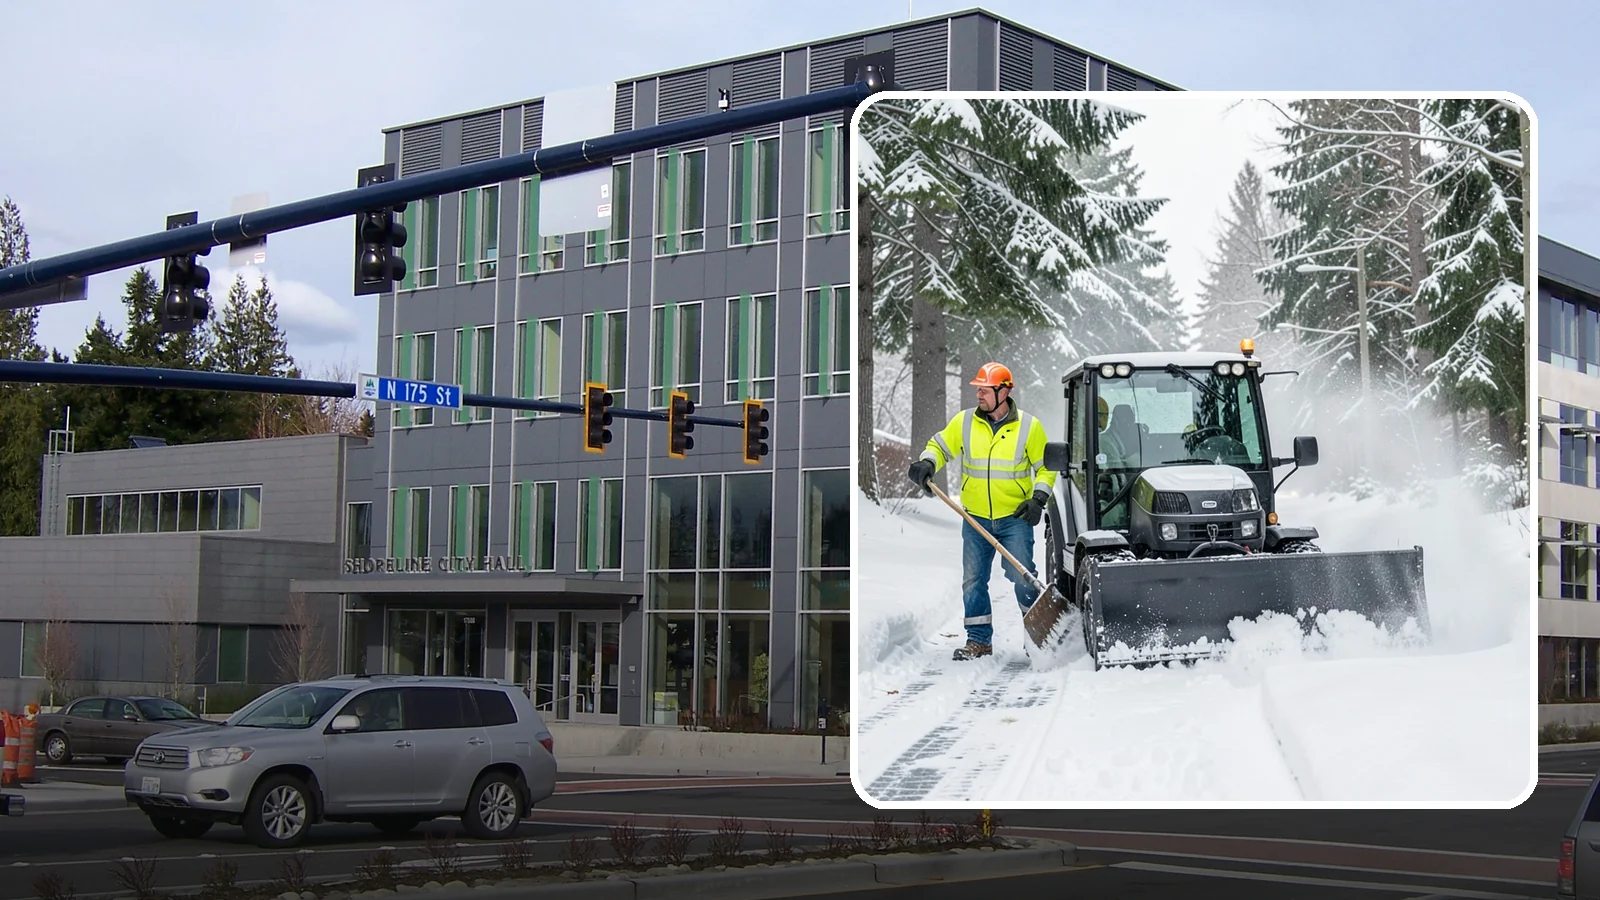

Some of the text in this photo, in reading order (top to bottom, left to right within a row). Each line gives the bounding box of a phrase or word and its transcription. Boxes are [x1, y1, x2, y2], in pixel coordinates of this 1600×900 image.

[387, 380, 451, 406] N 175 St
[344, 555, 526, 574] SHORELINE CITY HALL
